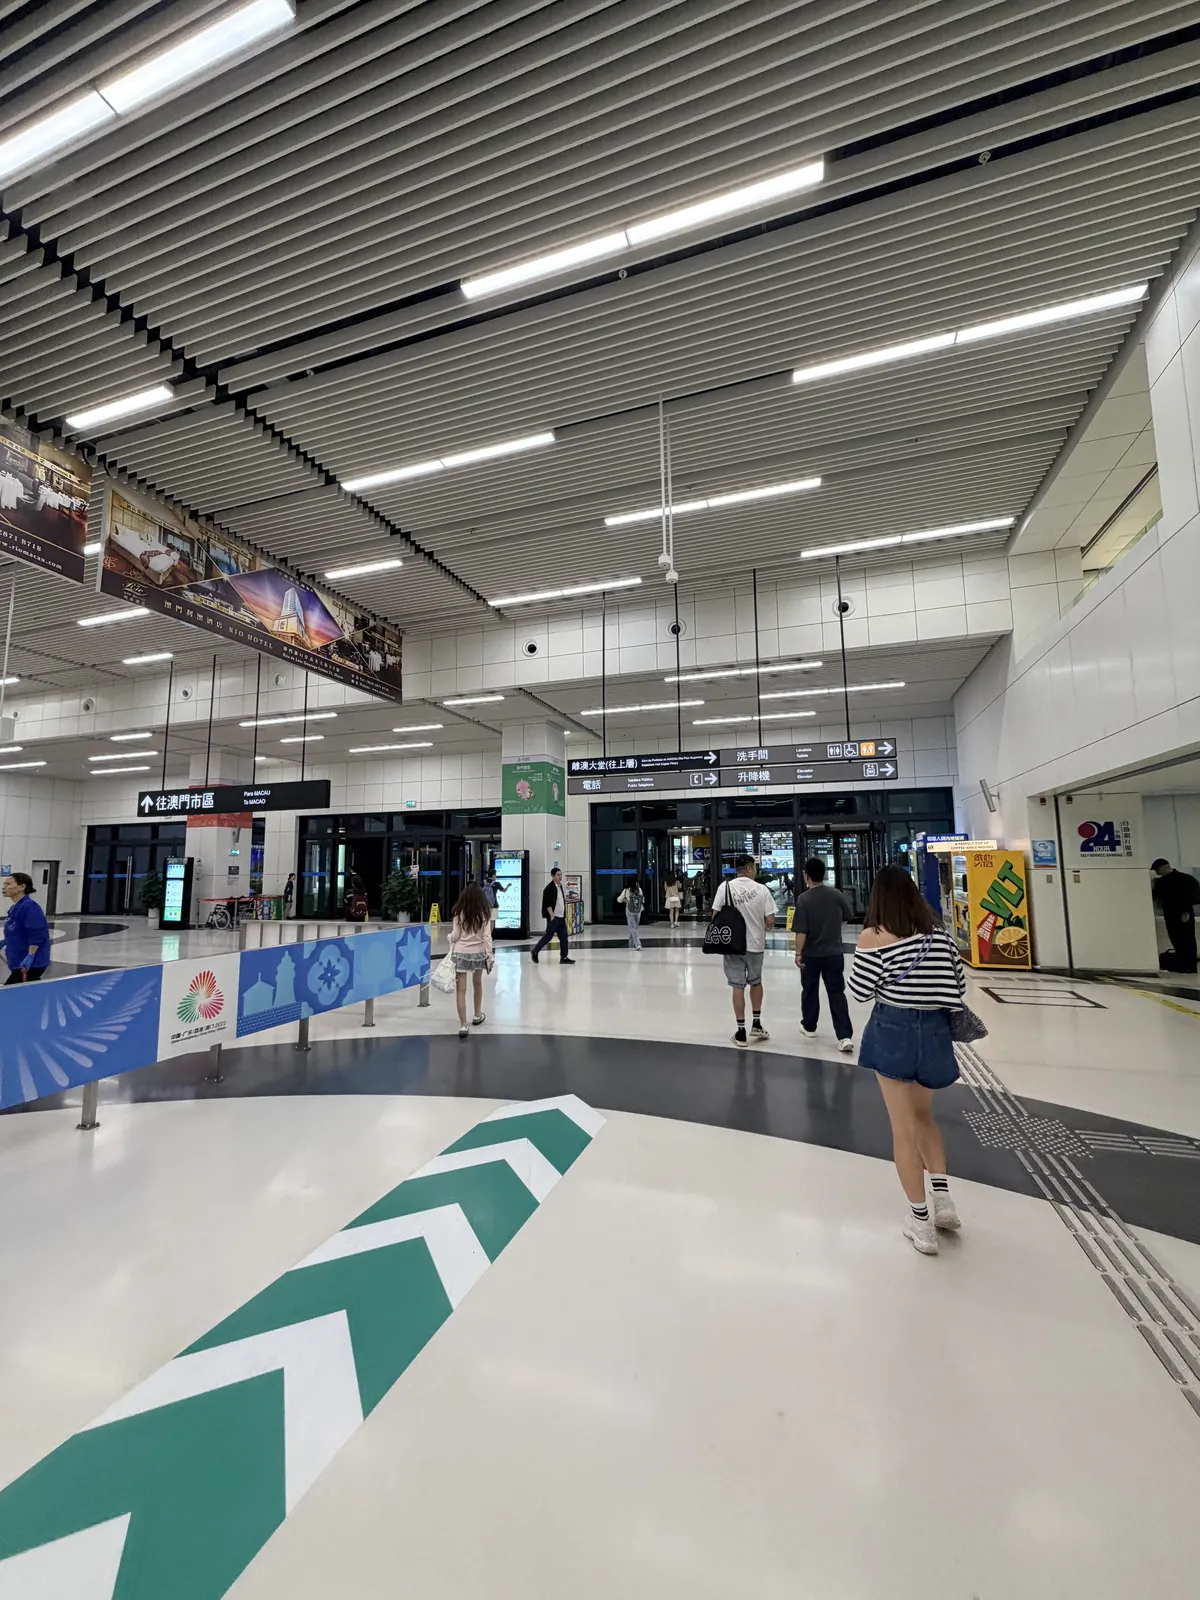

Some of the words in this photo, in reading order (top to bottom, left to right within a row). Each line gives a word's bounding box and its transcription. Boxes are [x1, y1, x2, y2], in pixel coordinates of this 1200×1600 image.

[247, 634, 273, 649] HOTEL
[737, 749, 768, 762] 洗手間
[571, 758, 638, 771] 離澳大堂(往上層)
[738, 770, 770, 783] 升降機
[583, 779, 601, 791] 電話
[156, 792, 215, 811] 往澳門市區
[1078, 821, 1121, 852] 24
[980, 859, 1025, 919] VLT
